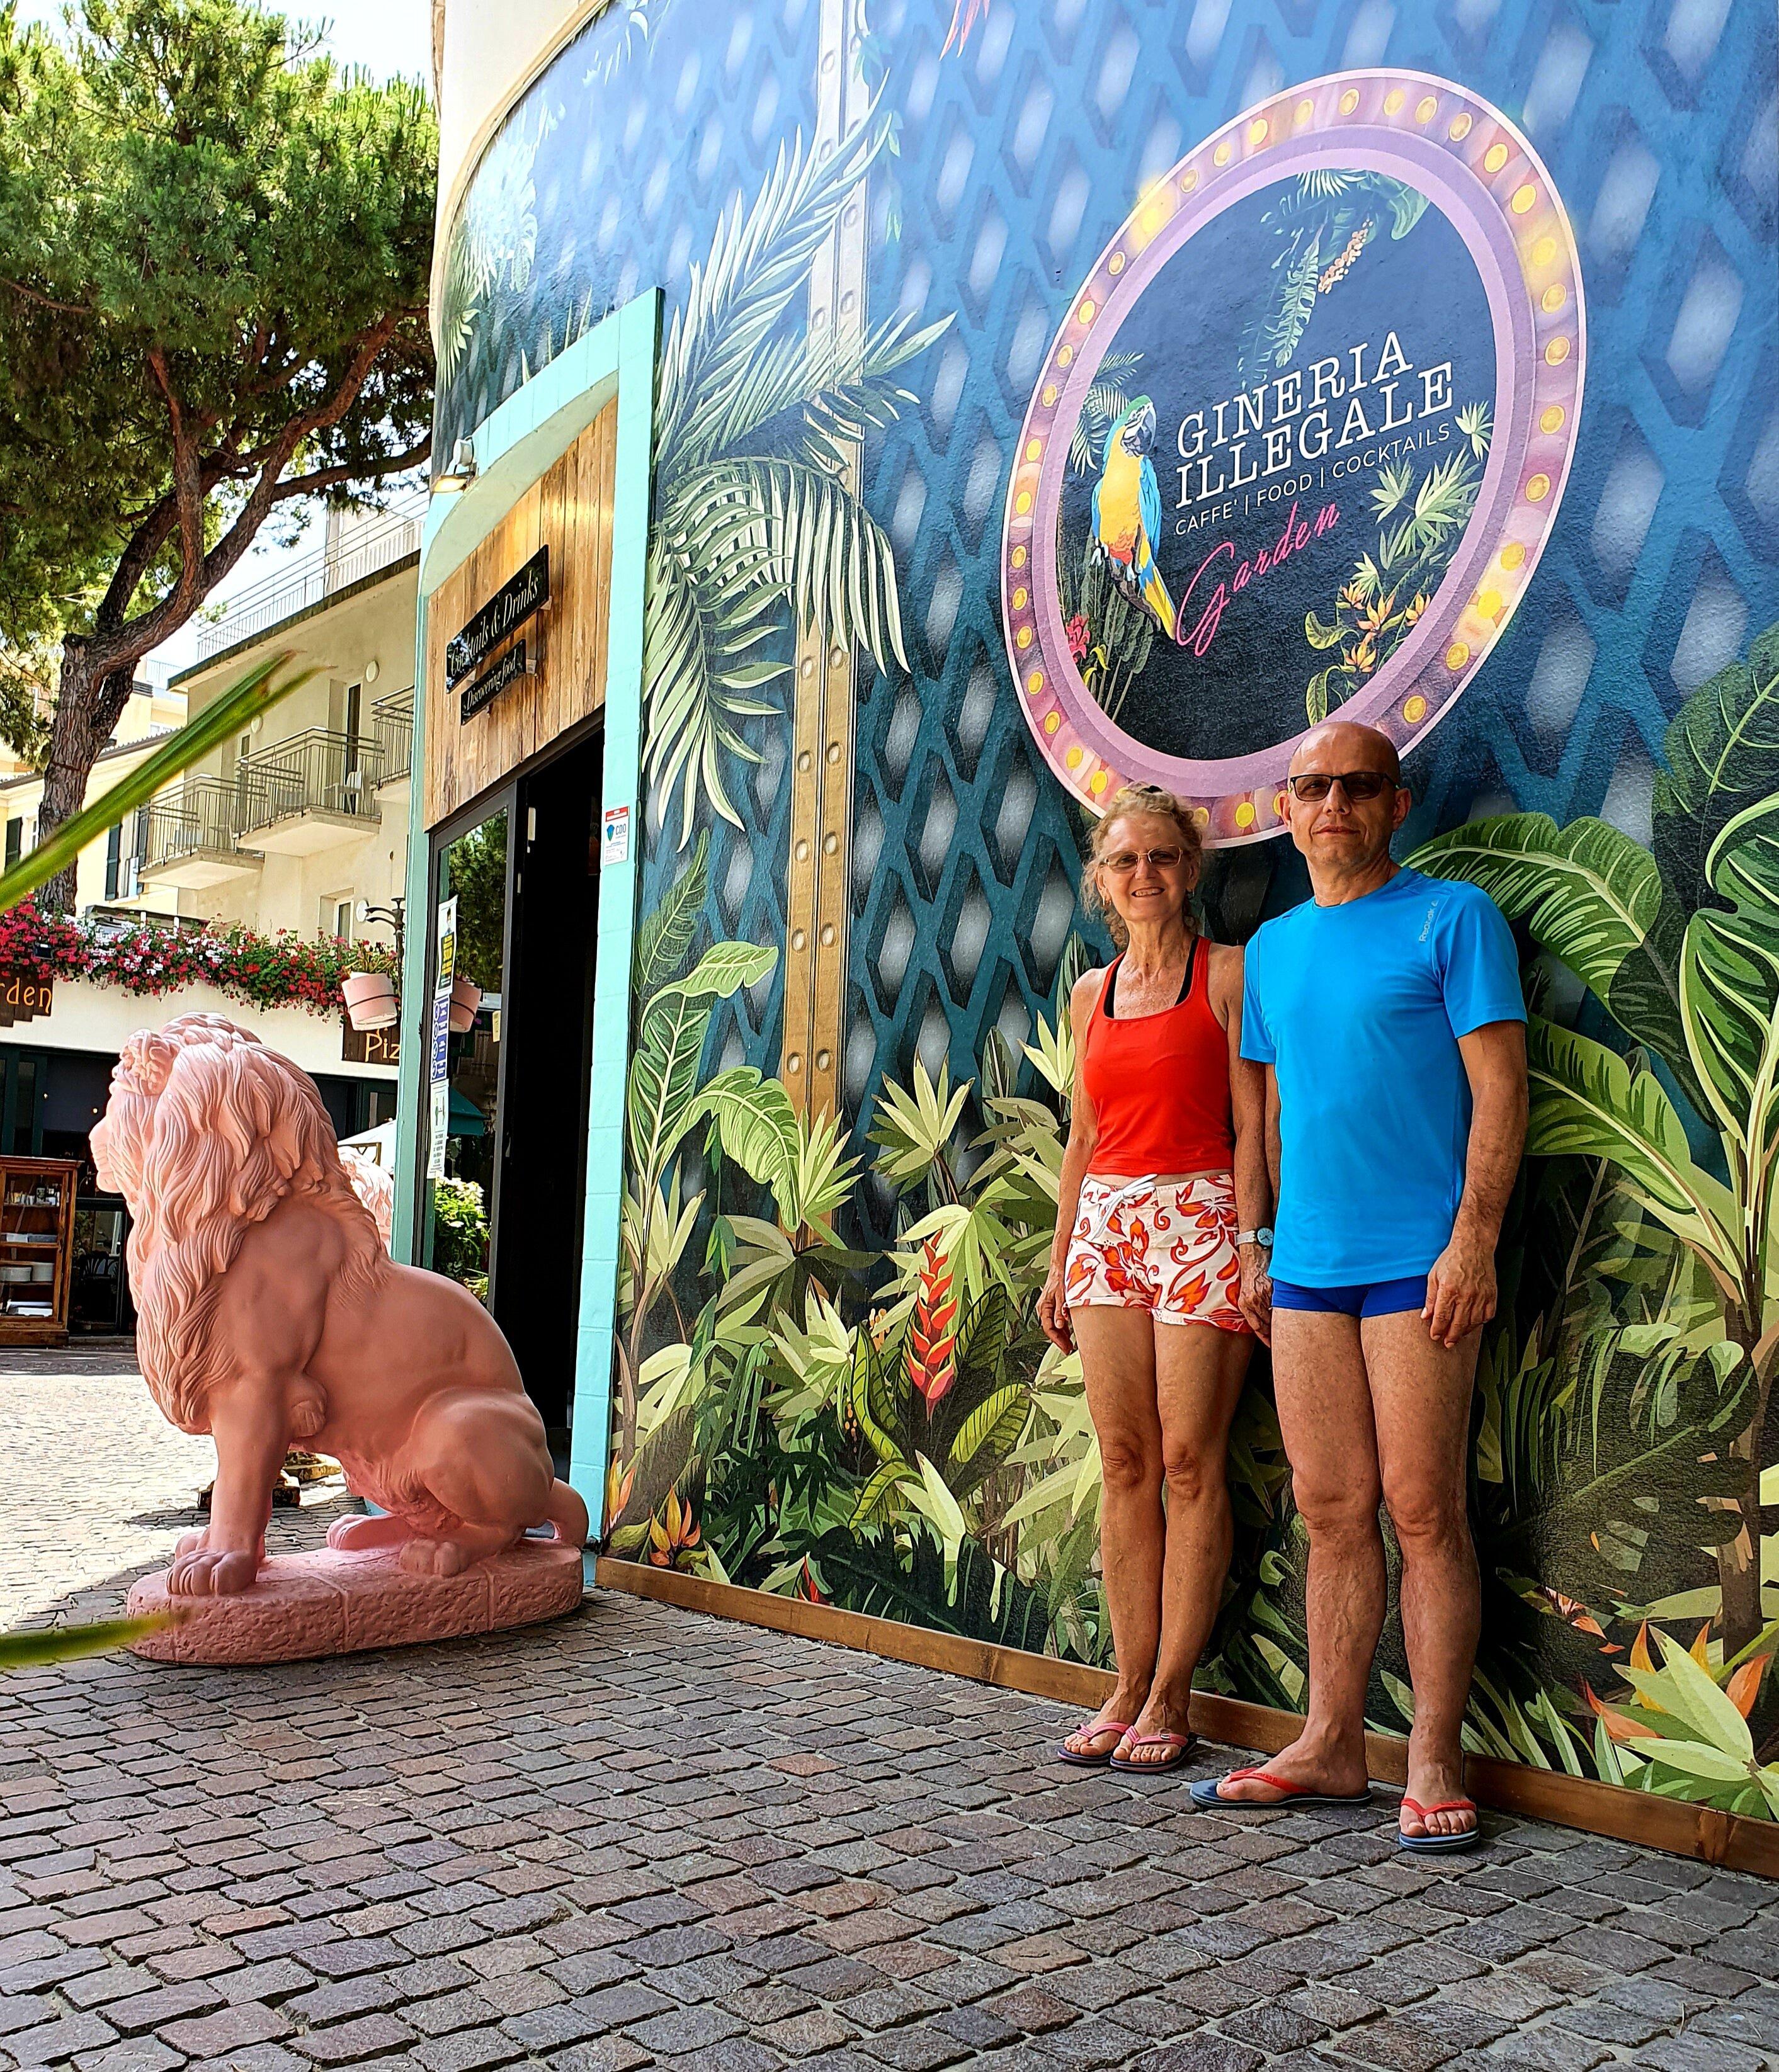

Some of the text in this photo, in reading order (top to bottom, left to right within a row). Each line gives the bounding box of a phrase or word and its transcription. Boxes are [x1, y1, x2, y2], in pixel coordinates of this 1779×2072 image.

[1176, 361, 1453, 509] ILLEGALE
[1177, 331, 1413, 459] GINERIA
[1175, 499, 1237, 536] CAFFE'
[1257, 473, 1312, 507] FOOD
[1333, 422, 1450, 478] COCKTAILS
[491, 604, 501, 638] &
[502, 569, 539, 629] Drinks
[1176, 501, 1341, 657] Garden
[467, 648, 517, 711] Discovering food
